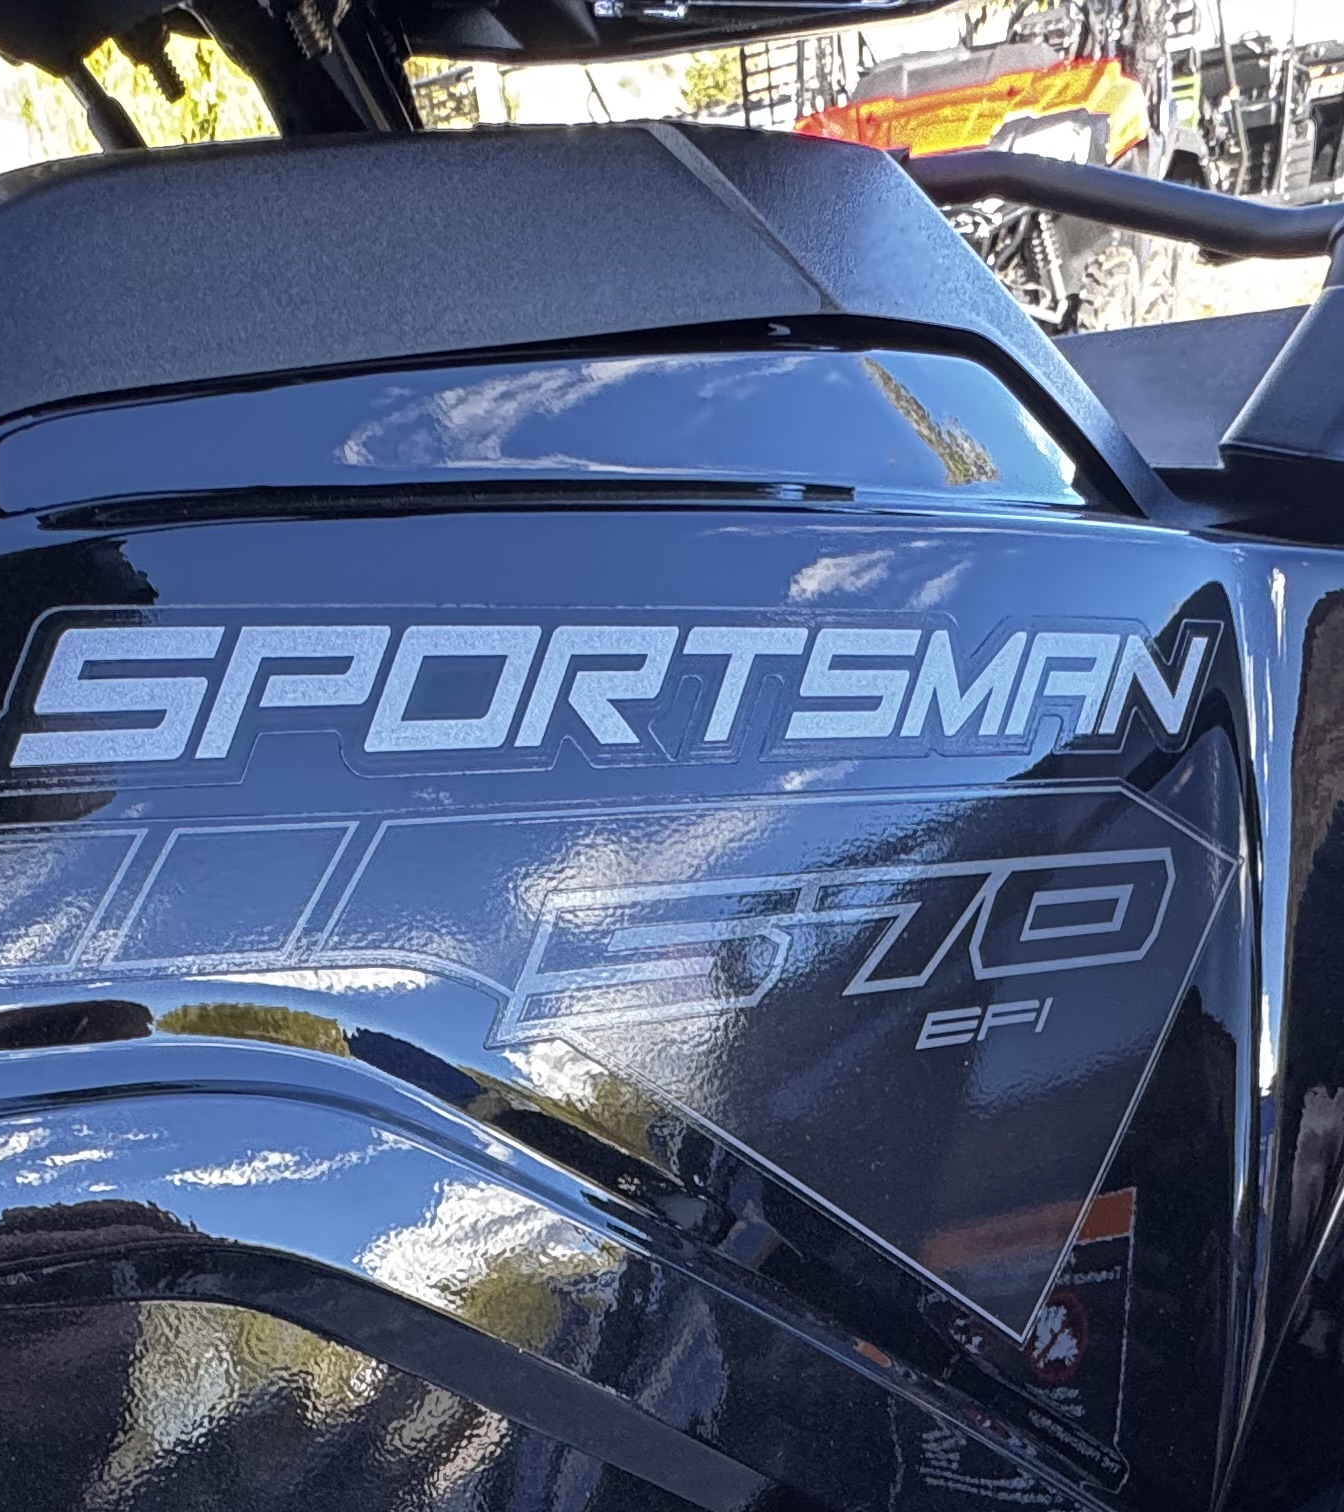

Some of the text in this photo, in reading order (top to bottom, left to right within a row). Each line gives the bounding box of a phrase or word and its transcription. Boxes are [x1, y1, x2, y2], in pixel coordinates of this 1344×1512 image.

[9, 622, 1210, 770] SPORTSMAN
[489, 848, 1175, 1050] 570
[915, 998, 1053, 1052] EFI
